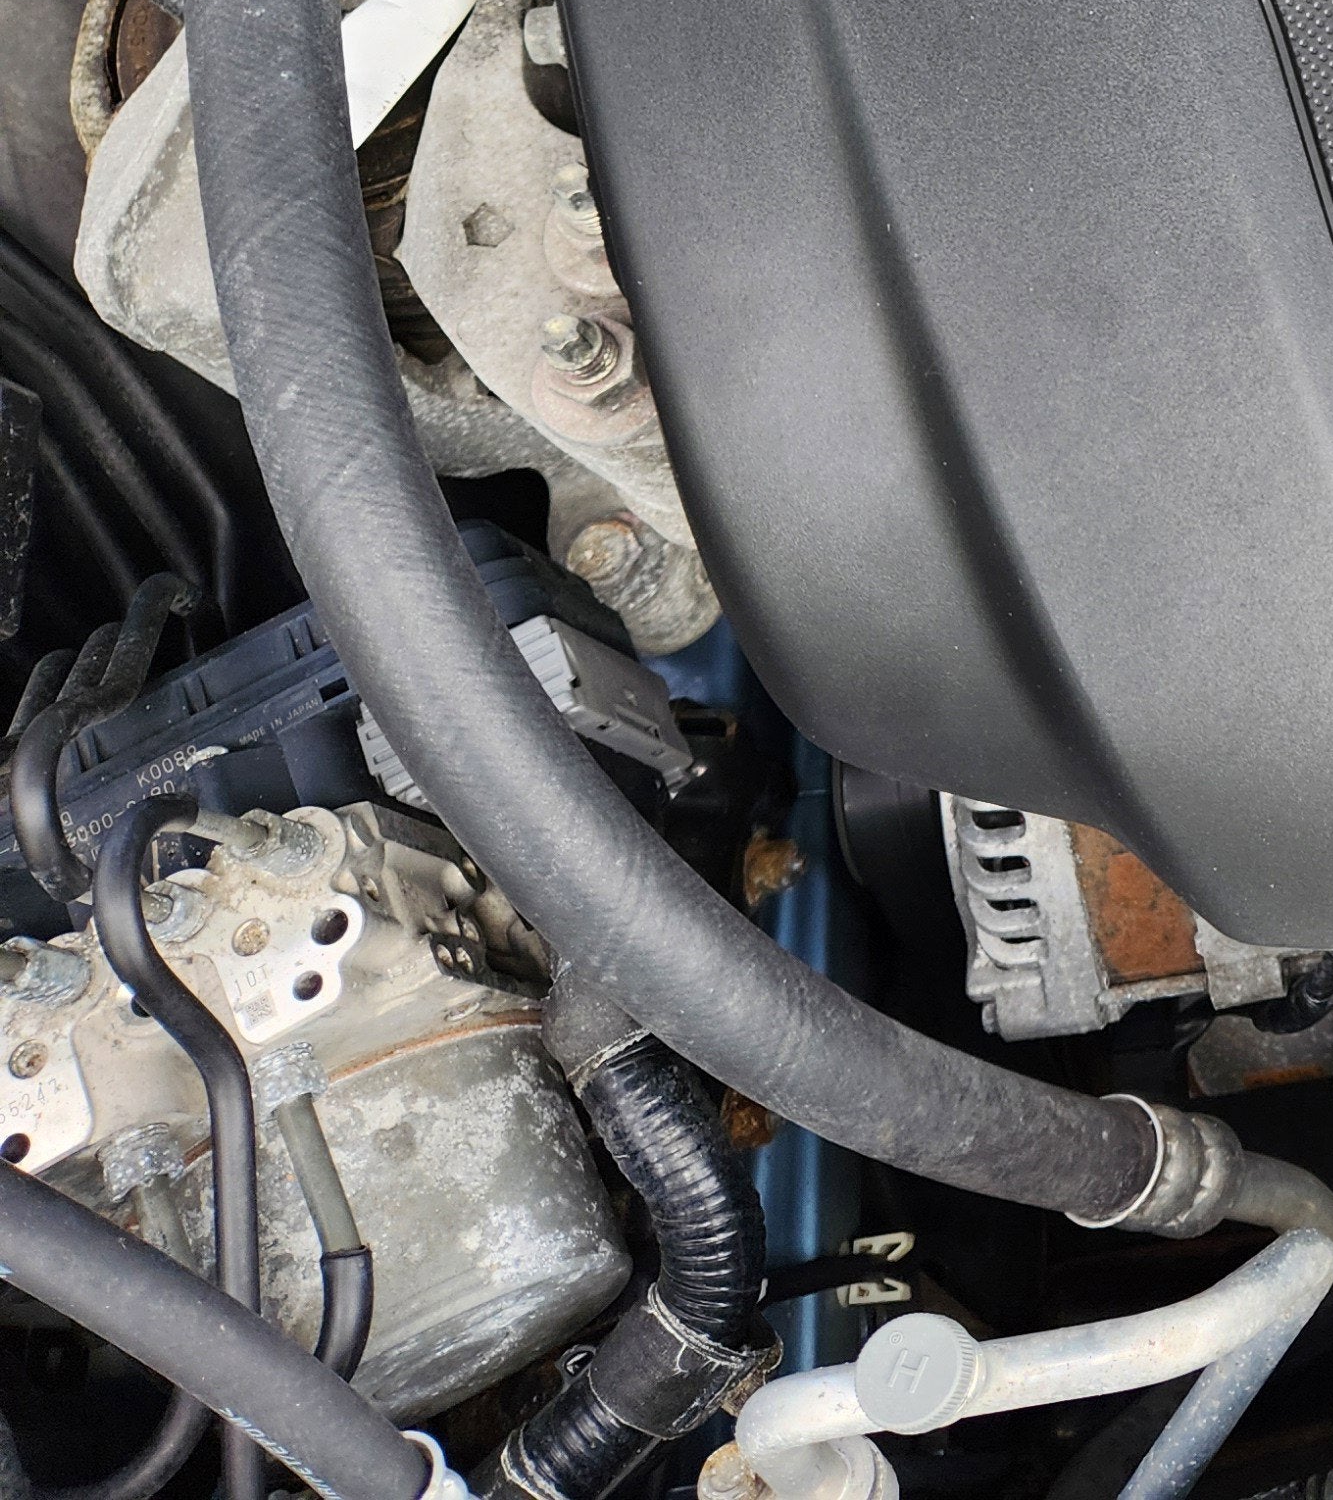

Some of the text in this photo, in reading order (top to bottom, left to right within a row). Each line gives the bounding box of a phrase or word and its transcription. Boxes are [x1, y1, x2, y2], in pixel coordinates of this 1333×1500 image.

[238, 699, 320, 747] MADE IN JAPAN
[888, 1348, 930, 1394] H
